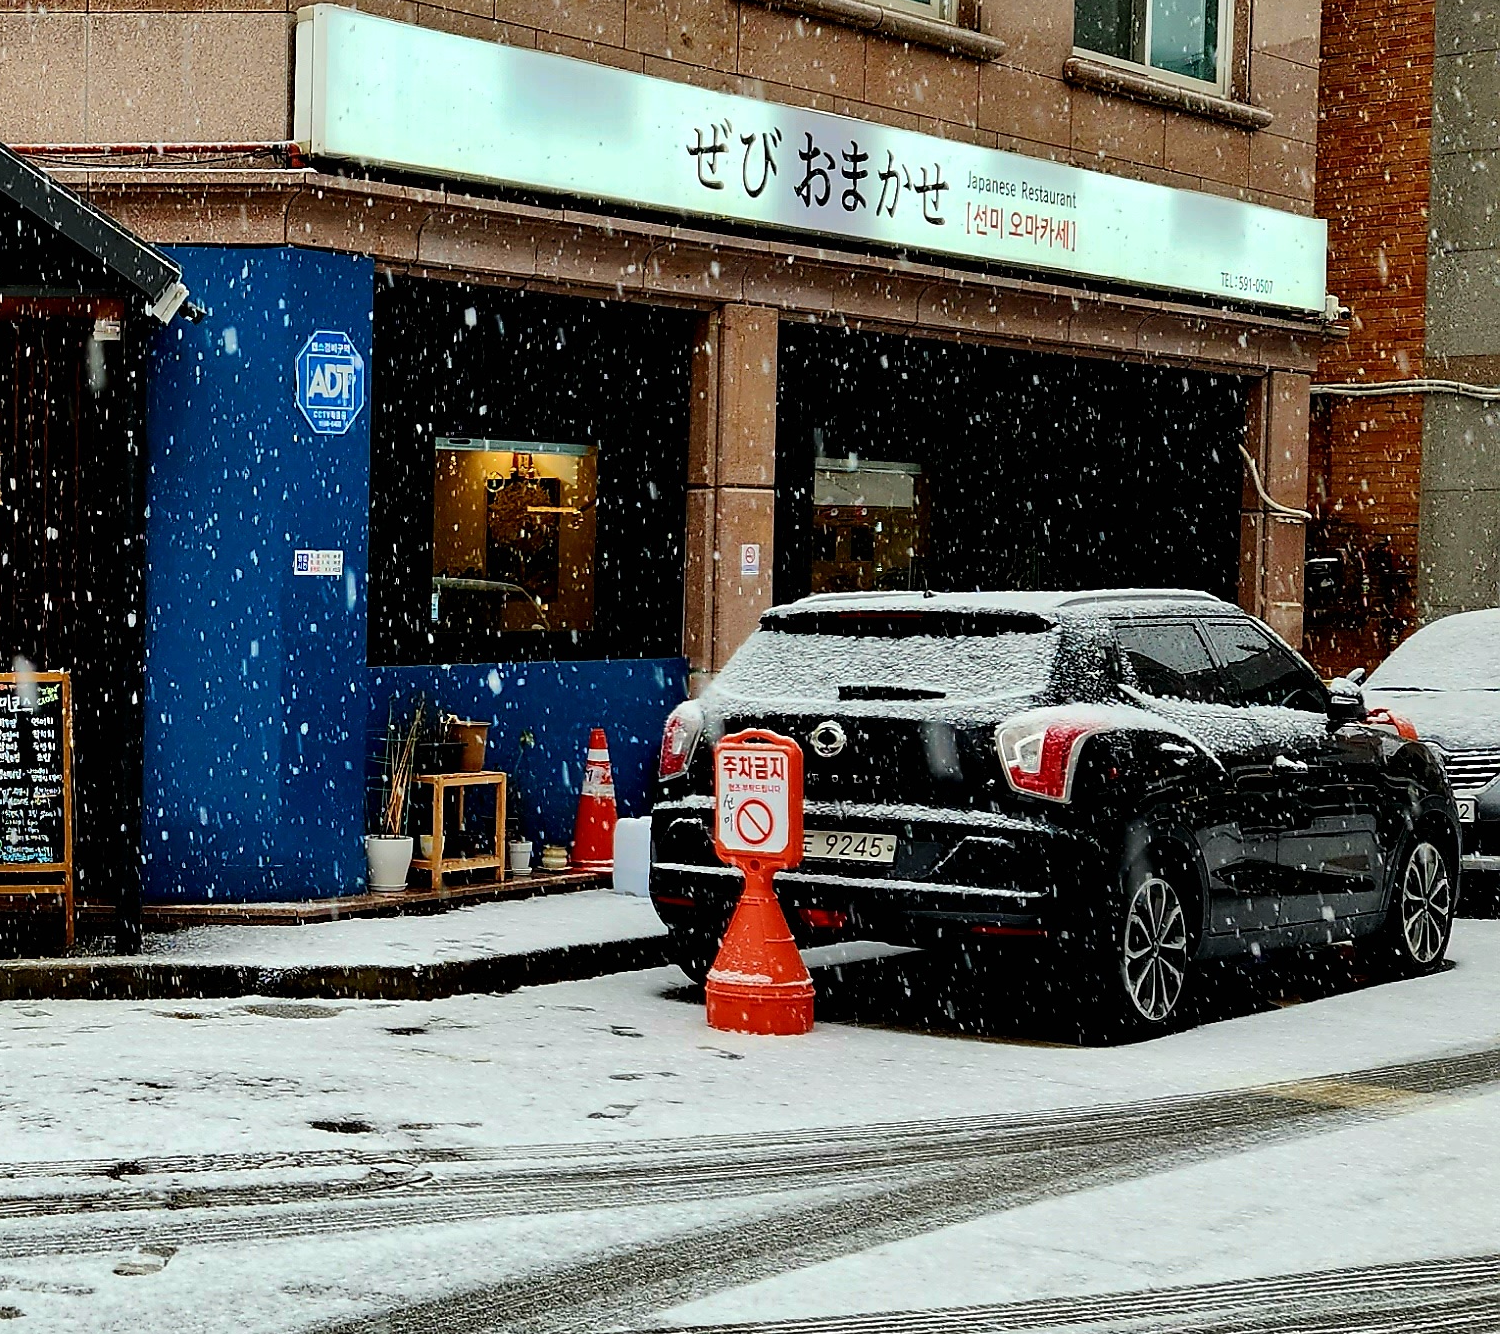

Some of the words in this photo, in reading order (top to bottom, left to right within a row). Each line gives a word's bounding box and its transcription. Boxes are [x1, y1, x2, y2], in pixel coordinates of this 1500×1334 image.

[967, 170, 1016, 197] Japanese
[1022, 181, 1077, 209] Restaurant
[308, 363, 354, 399] ADT
[723, 756, 785, 781] 주차금지
[826, 834, 884, 858] 9245
